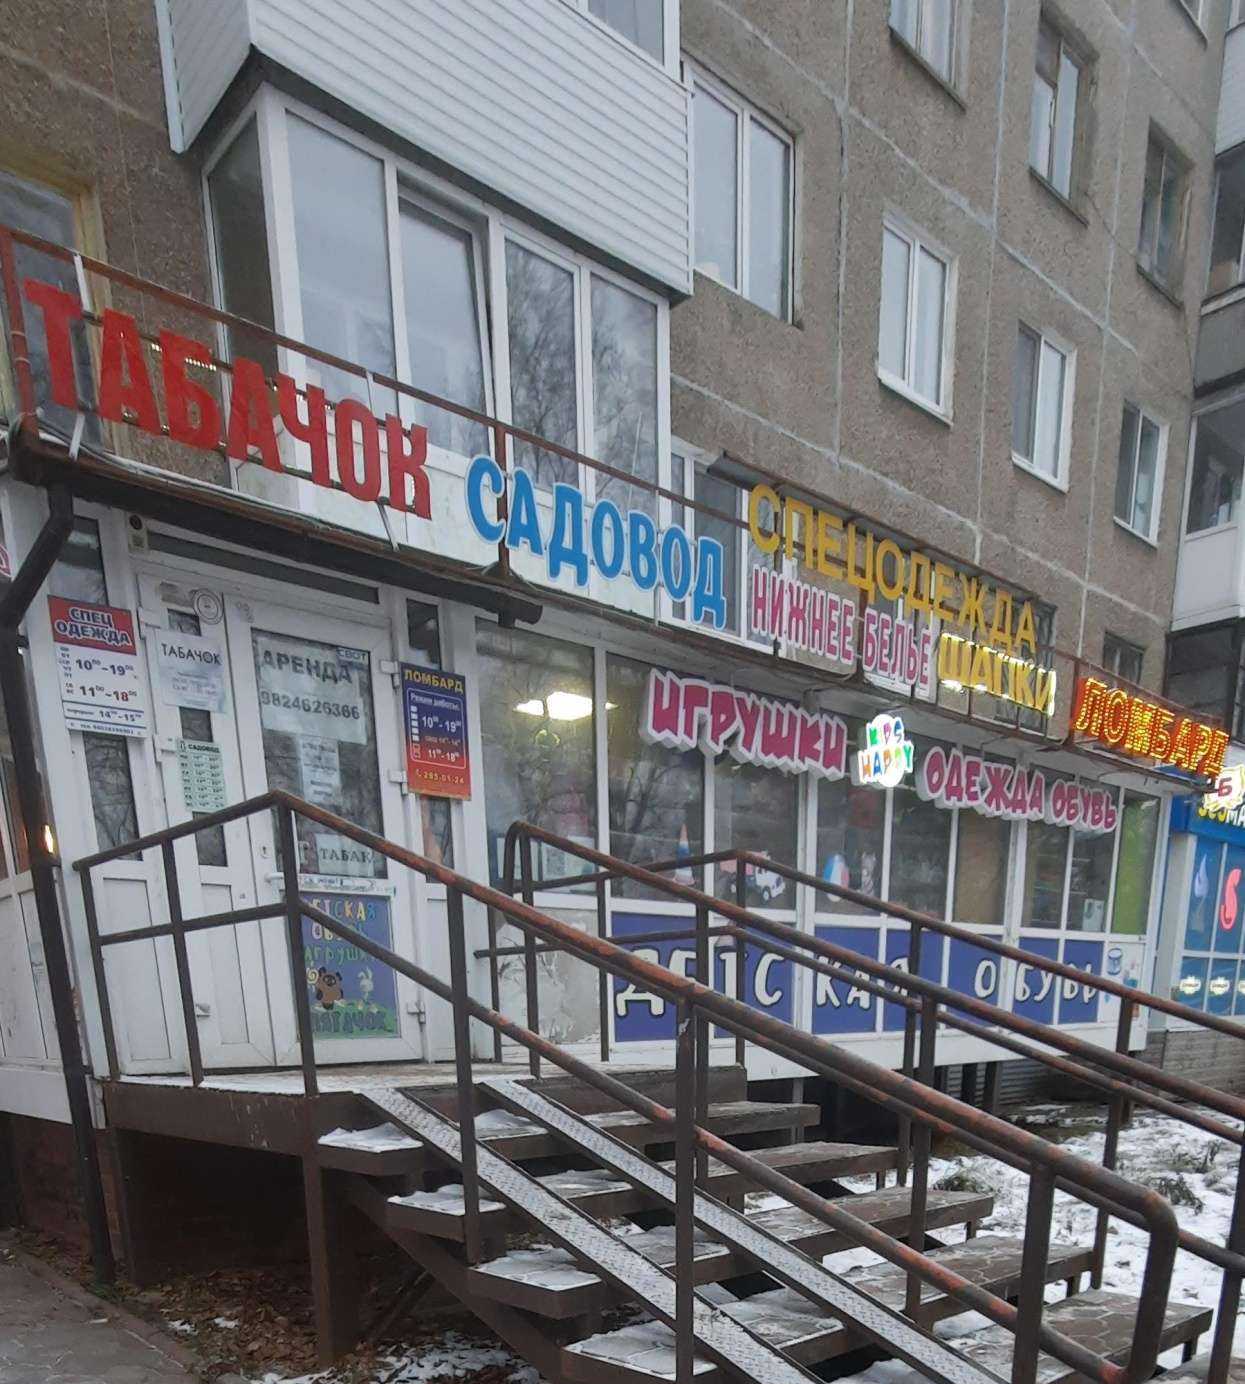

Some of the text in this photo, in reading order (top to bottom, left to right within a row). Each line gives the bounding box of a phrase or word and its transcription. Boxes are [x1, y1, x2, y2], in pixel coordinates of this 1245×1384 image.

[24, 279, 432, 521] ТАБАЧОК
[466, 455, 728, 630] САДОВОД
[750, 484, 1036, 653] СПЕЦОДЕЖДА
[55, 619, 133, 646] ОДЕЖДА
[70, 606, 113, 628] СПЕЦ
[161, 642, 222, 666] ТАБАЧОК
[752, 563, 933, 699] НИЖНЕЕ БЕЛЬЕ
[262, 650, 353, 684] АРЕНДА
[404, 669, 464, 693] ЛОМБАРД
[937, 632, 1057, 717] ШАПКИ
[649, 668, 848, 780] ИГРУШКИ
[1074, 676, 1230, 777] ЛОМБАРД
[924, 747, 1117, 832] ОДЕЖДА ОБУВЬ
[319, 847, 375, 864] ТАБАК
[312, 898, 376, 921] ЕТСКАЯ
